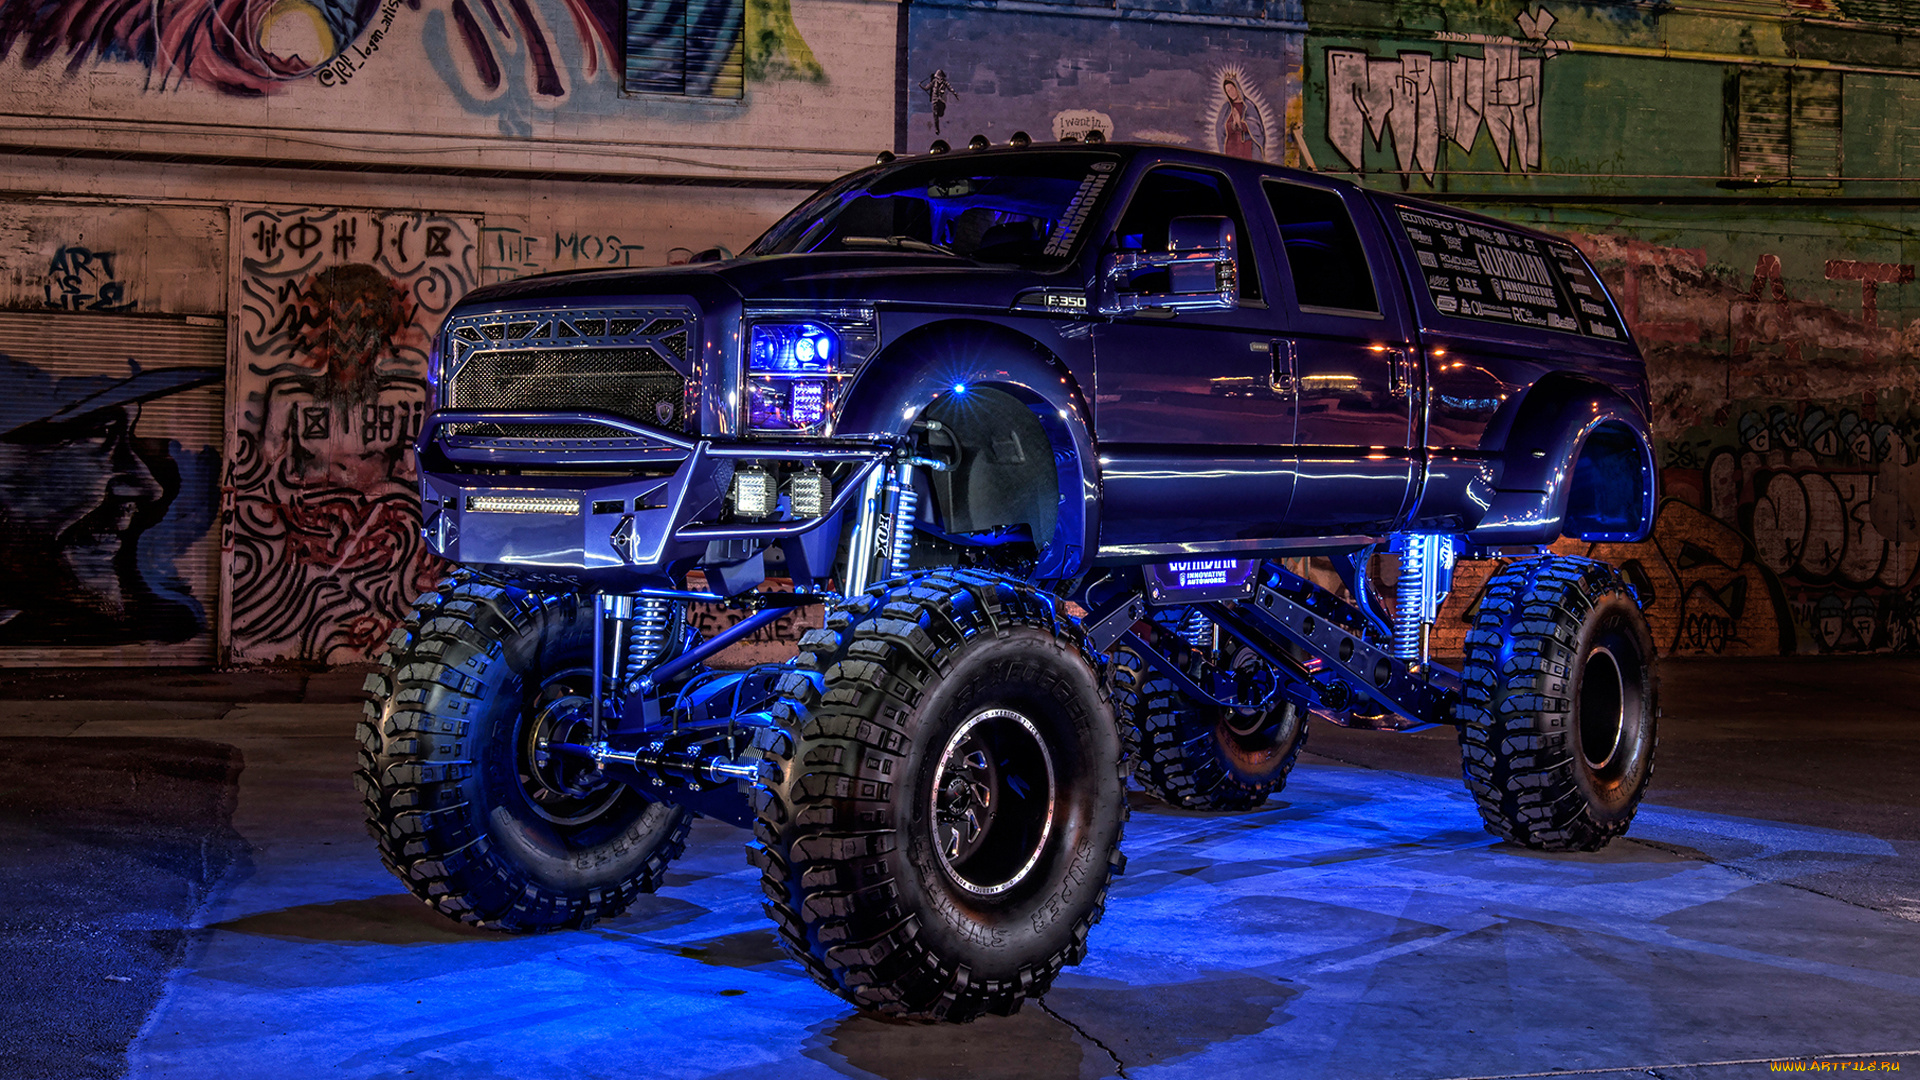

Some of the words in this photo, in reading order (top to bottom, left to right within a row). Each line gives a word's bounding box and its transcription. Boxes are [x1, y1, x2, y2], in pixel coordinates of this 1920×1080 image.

[1066, 117, 1090, 127] want
[1043, 174, 1096, 255] AUTOWORKS
[1054, 174, 1110, 257] INNOVATIVE
[48, 244, 116, 279] ART
[480, 227, 540, 267] THE
[555, 231, 645, 267] MOST
[1474, 243, 1553, 287] GUARDIAN
[44, 281, 138, 311] LIFE
[56, 275, 82, 293] IS
[1500, 280, 1555, 299] INNOVATIVE
[1505, 291, 1558, 309] AUTOWORKS
[874, 513, 891, 558] FOX
[1187, 570, 1226, 579] INNOVATIVE
